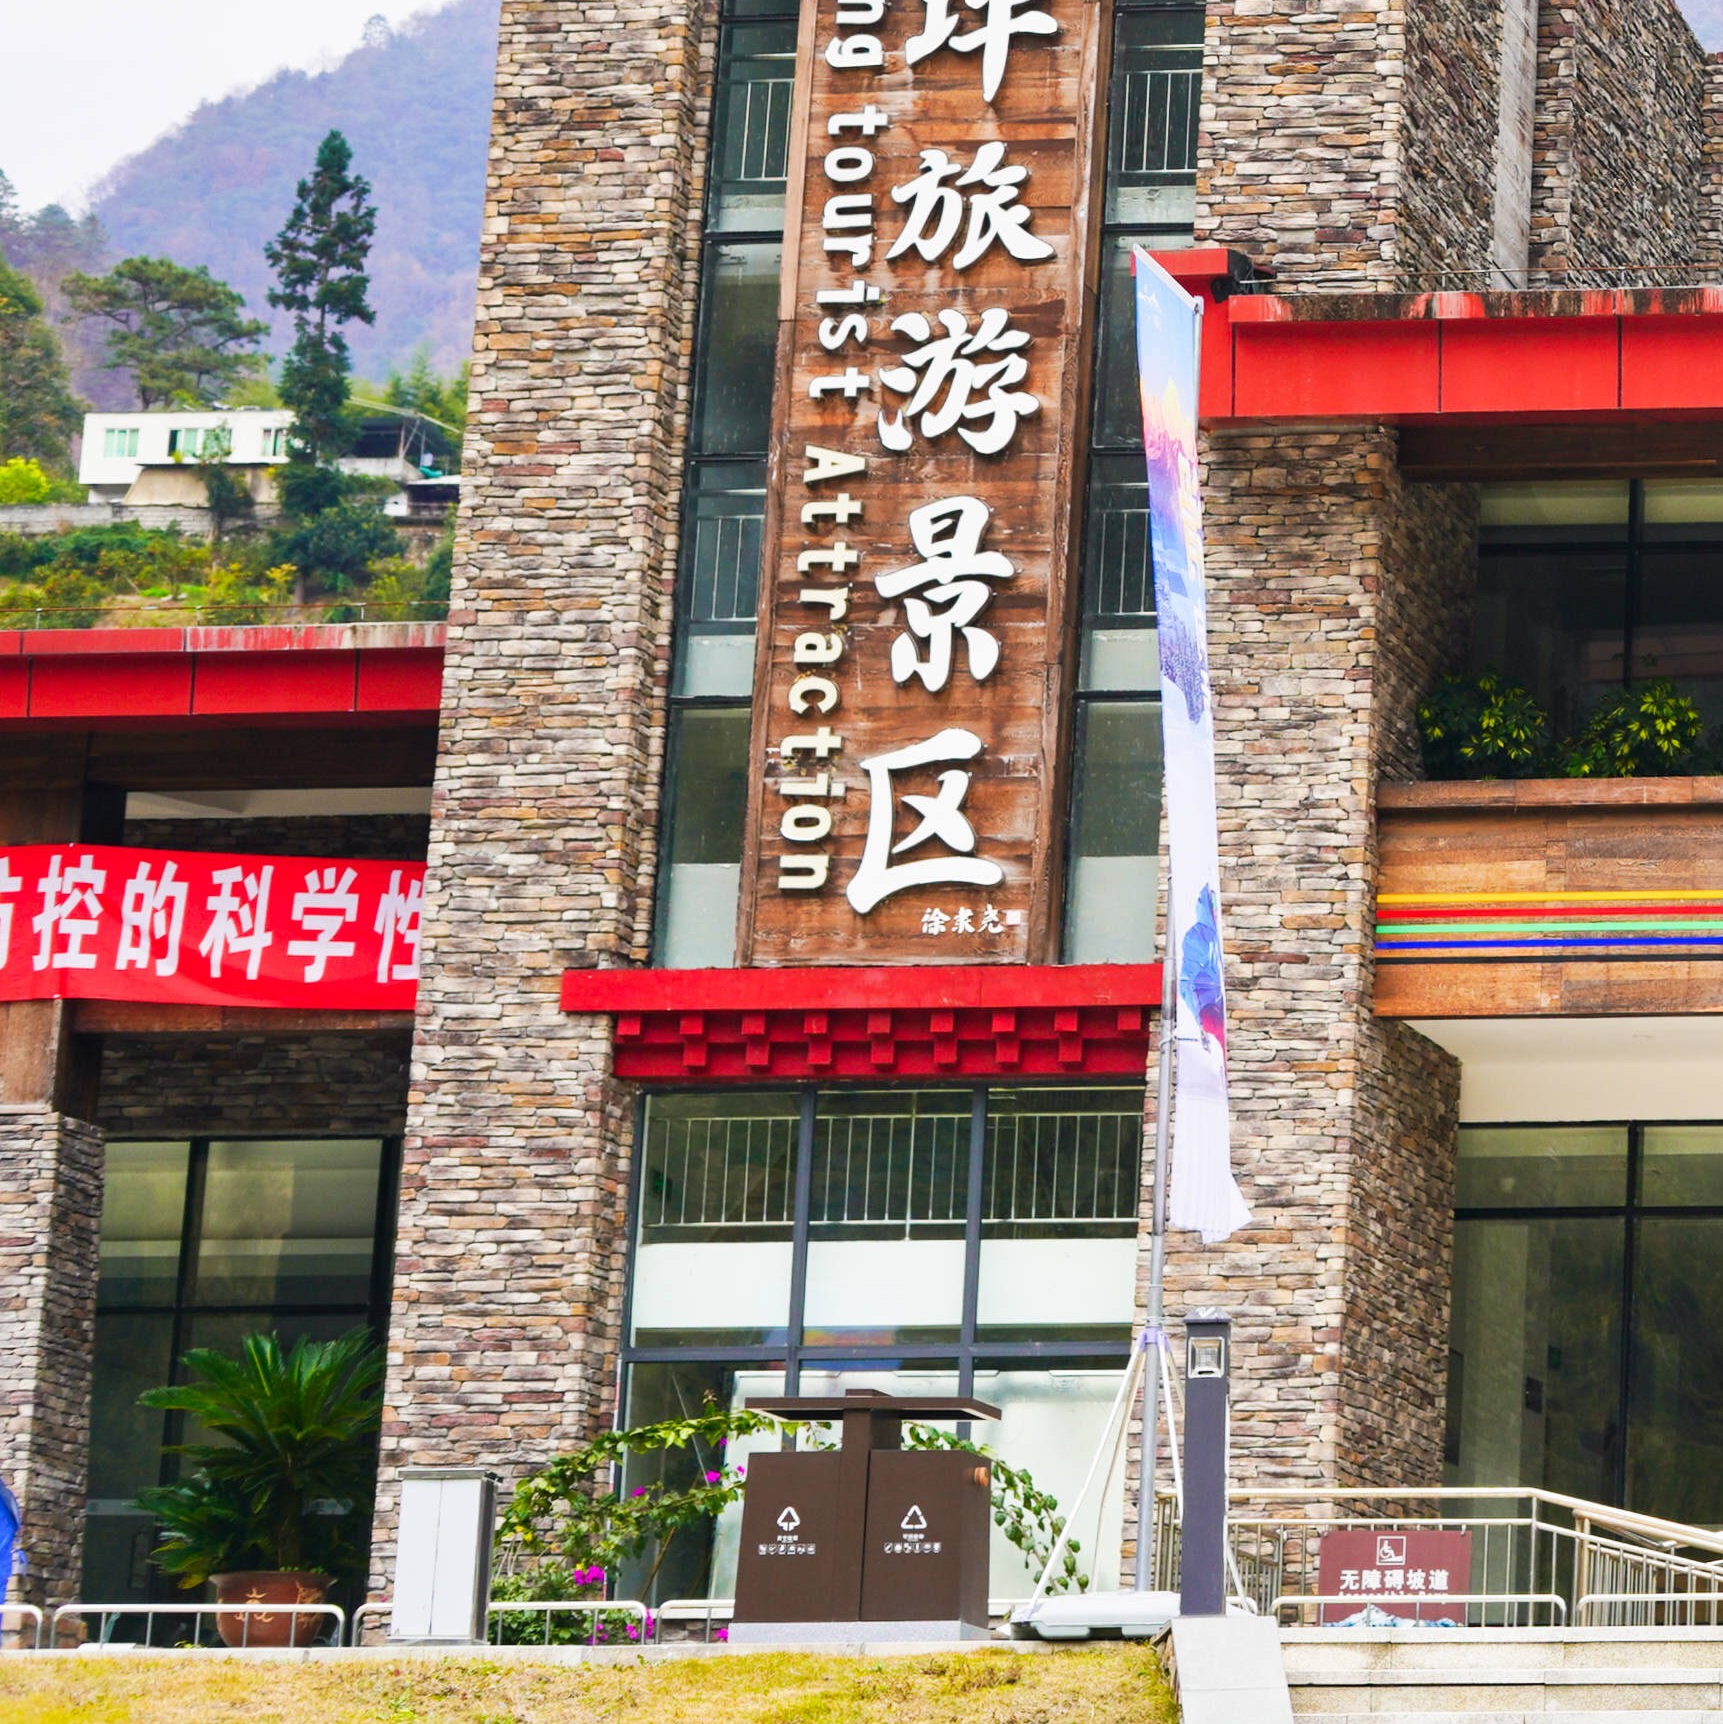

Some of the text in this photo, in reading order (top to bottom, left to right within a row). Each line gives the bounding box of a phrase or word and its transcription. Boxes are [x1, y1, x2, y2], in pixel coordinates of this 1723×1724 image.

[809, 104, 890, 401] tourist
[777, 444, 867, 892] Attraction
[1340, 1568, 1449, 1590] 无障碍坡道
